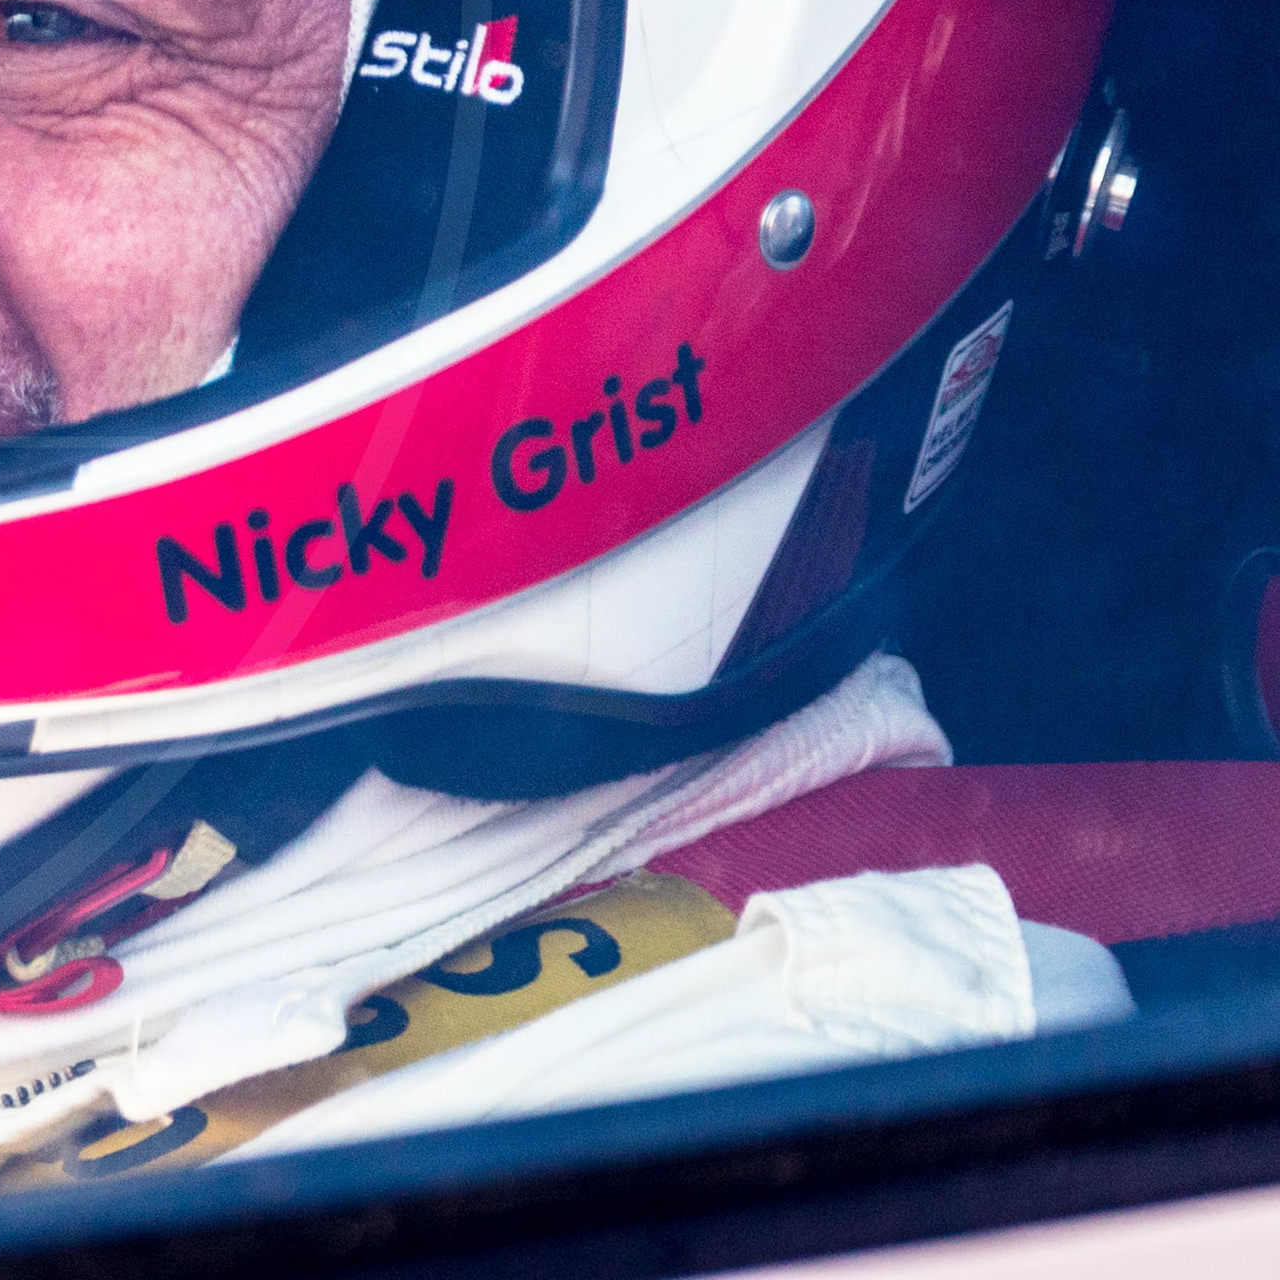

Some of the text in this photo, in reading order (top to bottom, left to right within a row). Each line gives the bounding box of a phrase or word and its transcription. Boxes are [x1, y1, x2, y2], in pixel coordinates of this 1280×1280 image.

[359, 19, 525, 106] Stilo
[154, 343, 708, 626] Nicky Grist
